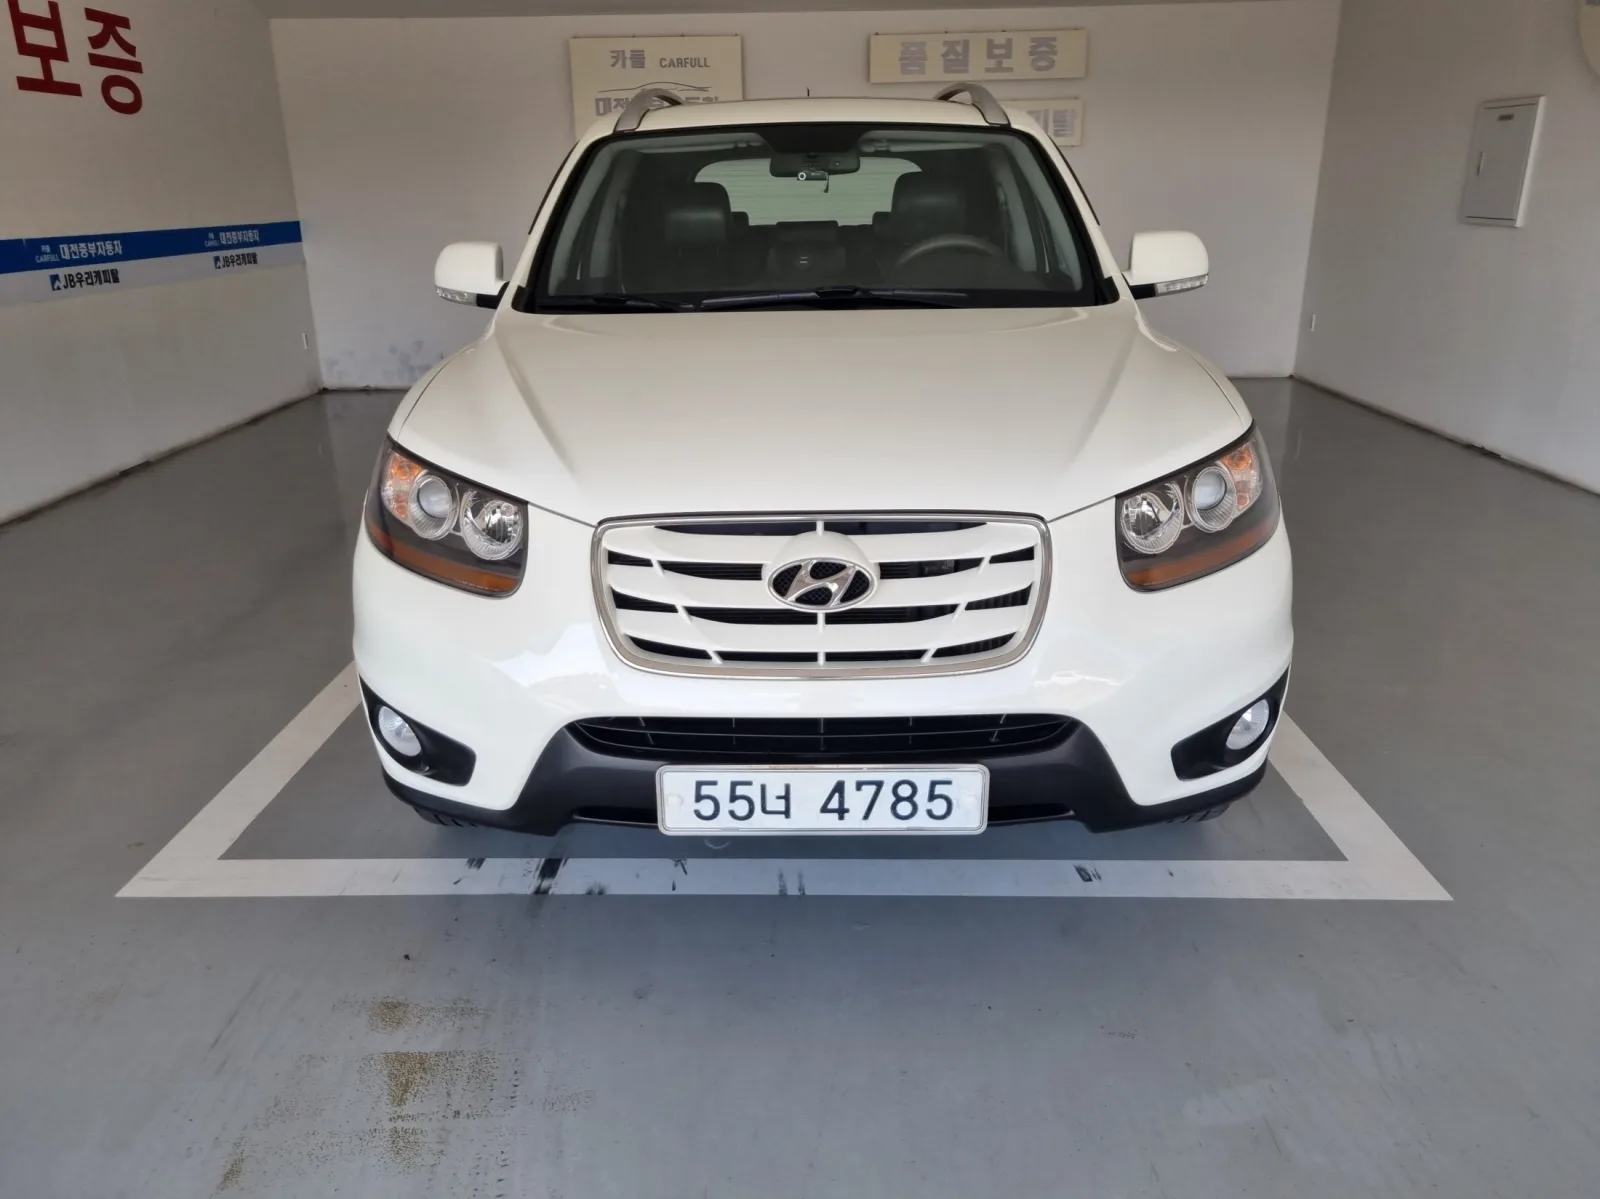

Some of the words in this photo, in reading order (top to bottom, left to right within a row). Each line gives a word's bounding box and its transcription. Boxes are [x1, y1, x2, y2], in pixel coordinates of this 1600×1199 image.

[659, 57, 711, 68] CARFULL
[899, 35, 1058, 76] 품질보증
[59, 239, 123, 260] 대전중부자동차
[693, 780, 791, 821] 55너
[819, 779, 953, 821] 4785
